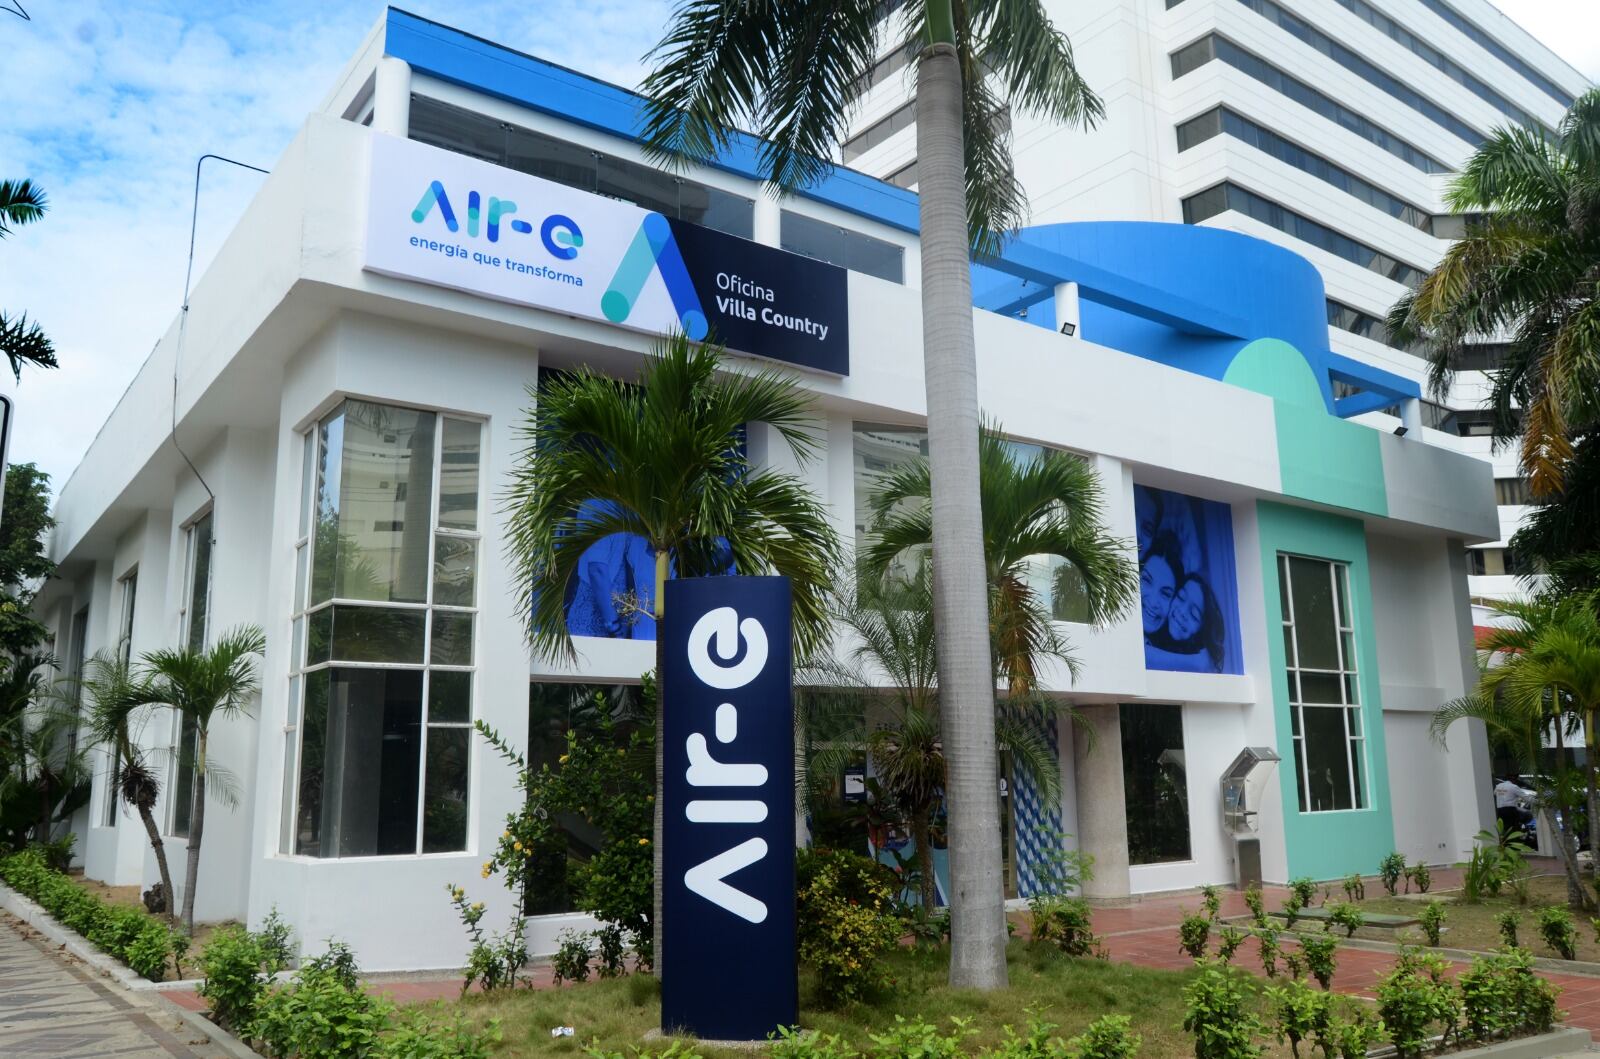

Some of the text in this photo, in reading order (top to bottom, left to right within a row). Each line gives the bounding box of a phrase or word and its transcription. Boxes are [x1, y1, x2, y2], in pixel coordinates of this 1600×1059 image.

[409, 235, 583, 287] energía que transforma
[716, 272, 774, 302] Oficina
[716, 295, 829, 341] Villa Country
